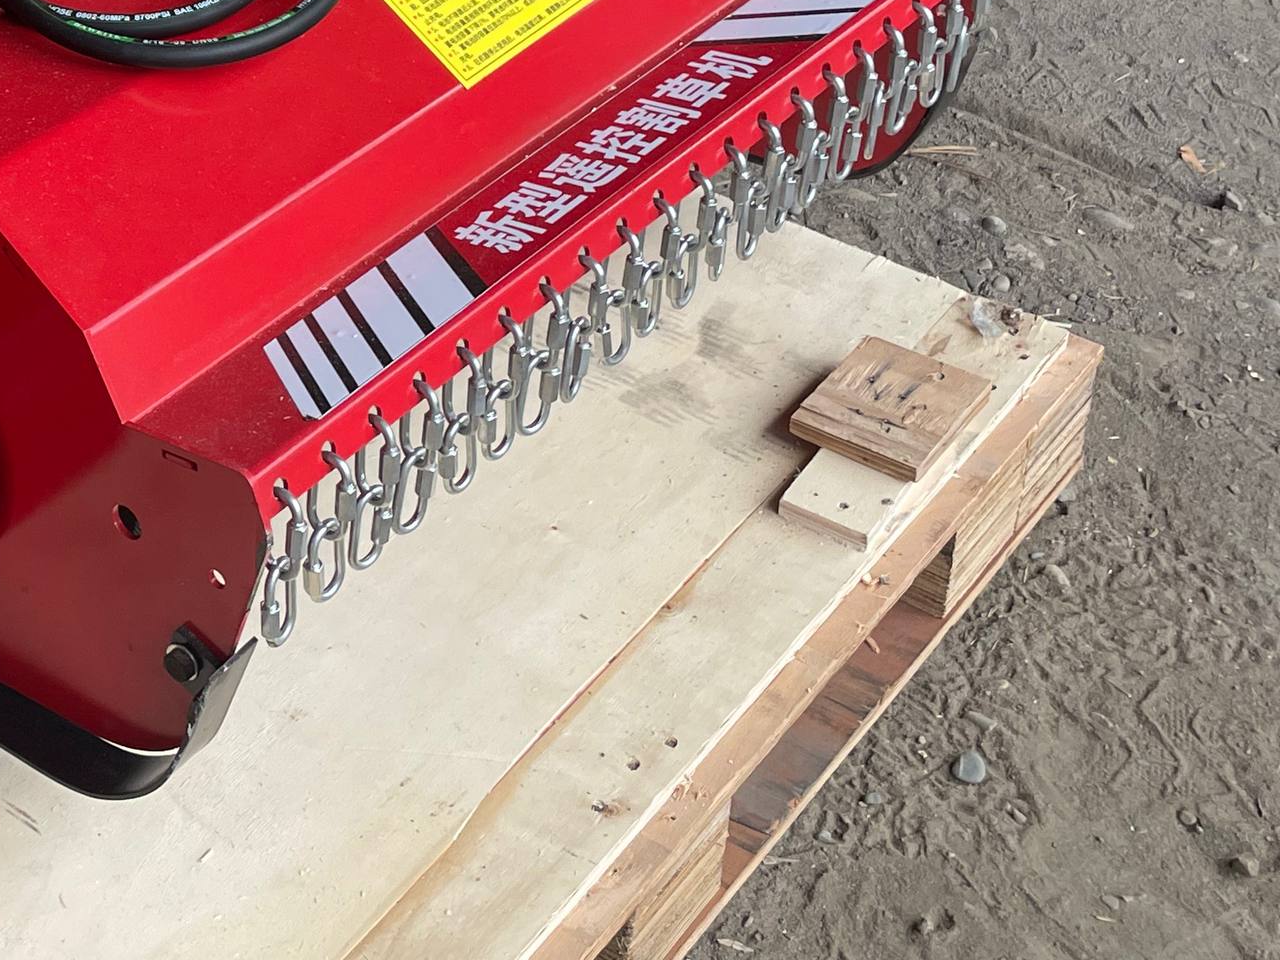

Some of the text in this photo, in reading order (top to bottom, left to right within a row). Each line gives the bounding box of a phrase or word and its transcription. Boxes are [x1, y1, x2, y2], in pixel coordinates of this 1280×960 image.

[454, 49, 775, 254] 新型遥控割草机
